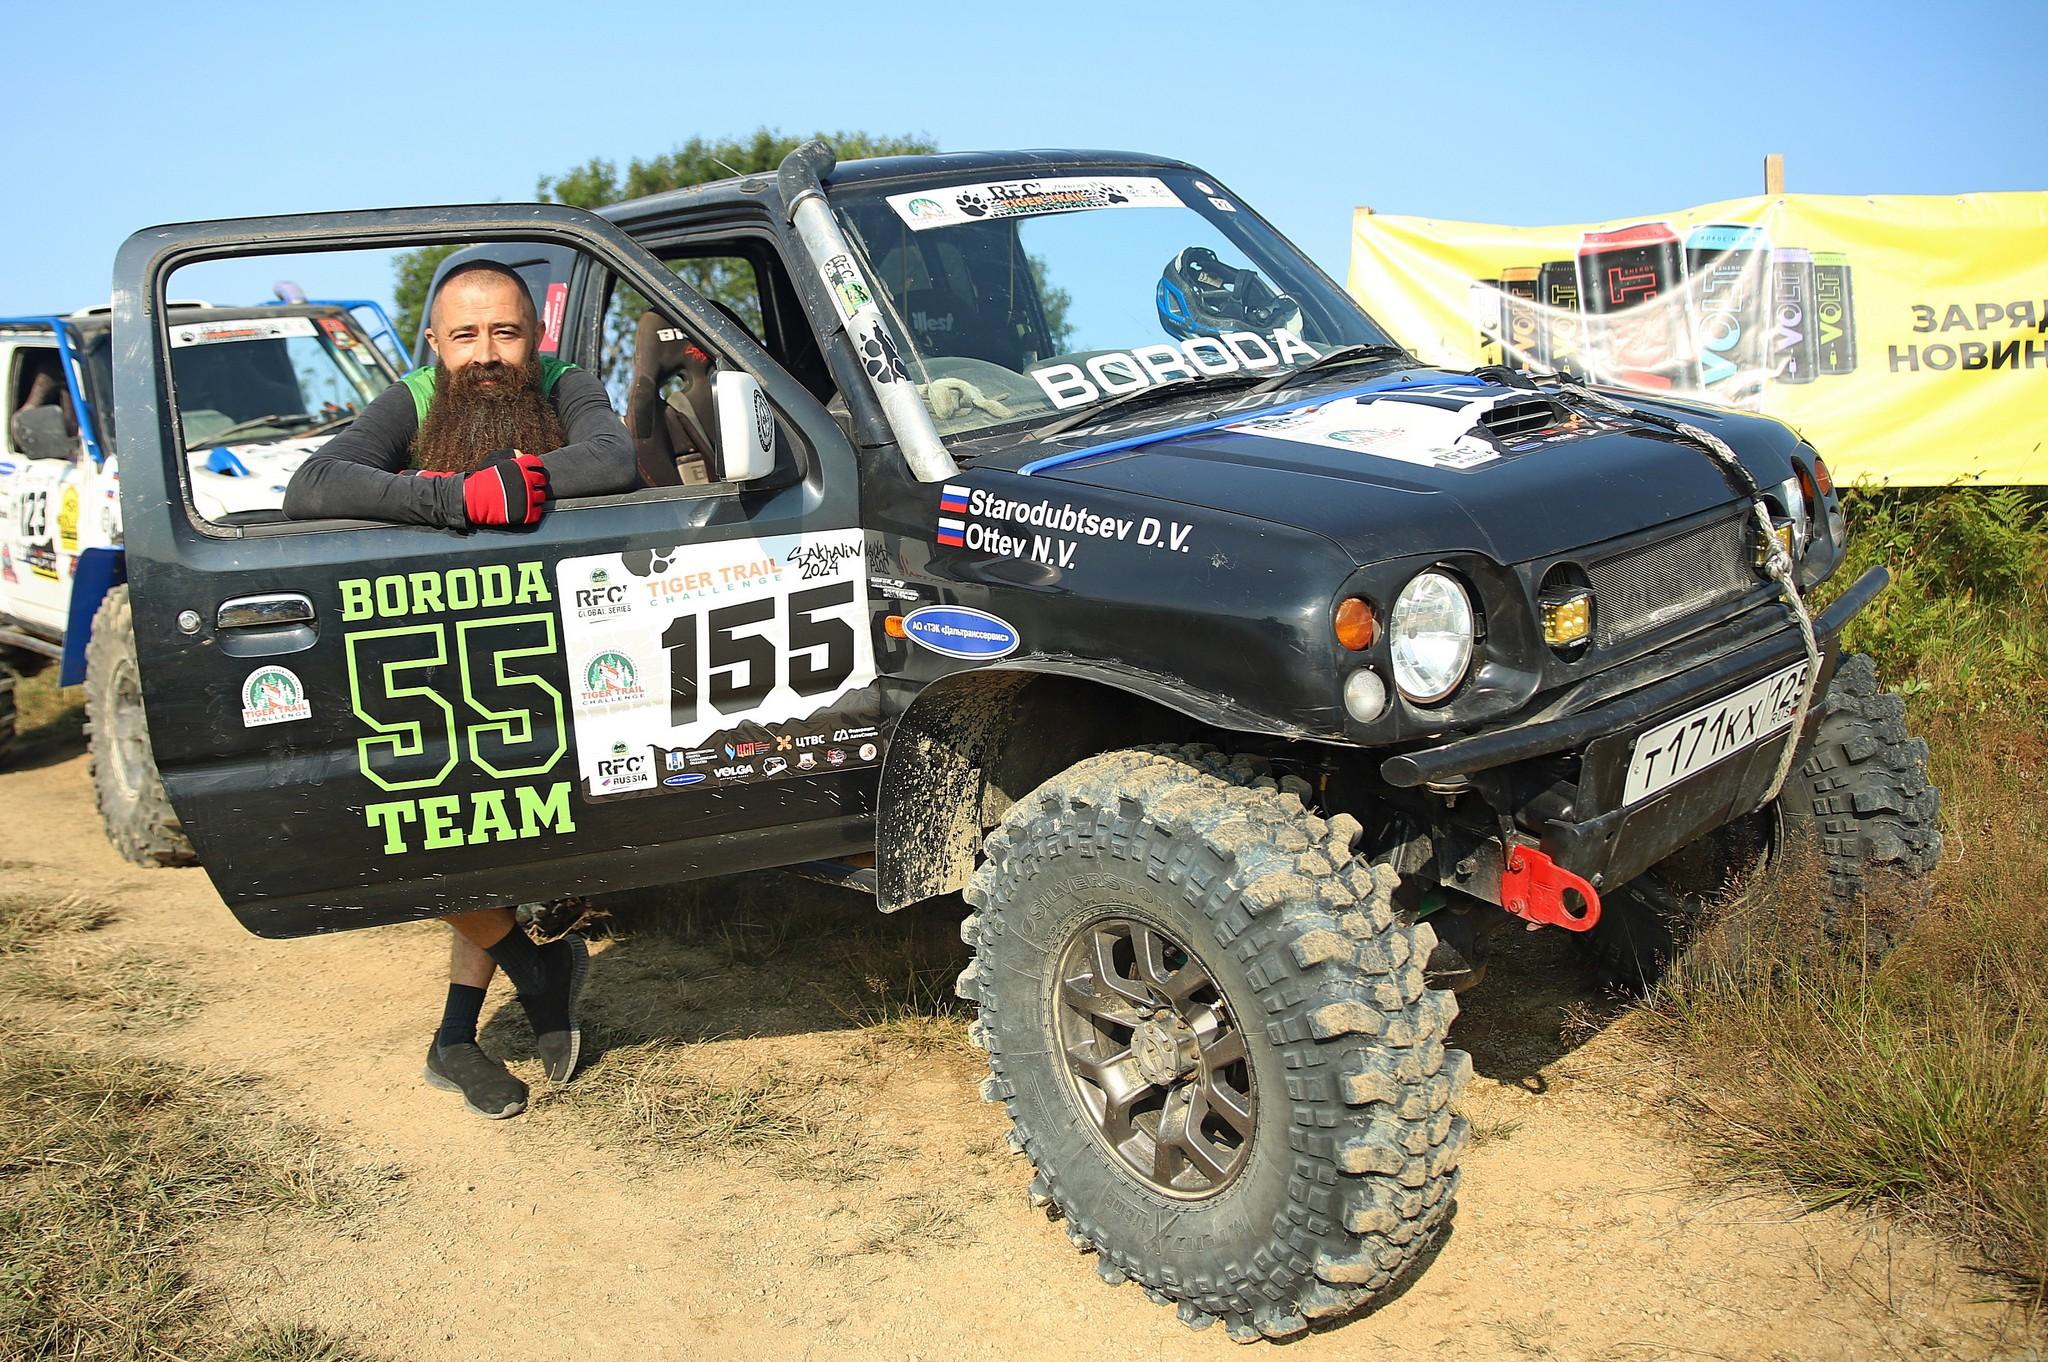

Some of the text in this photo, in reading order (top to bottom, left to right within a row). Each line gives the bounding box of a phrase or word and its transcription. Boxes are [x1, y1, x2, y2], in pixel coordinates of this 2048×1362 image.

[1774, 270, 1804, 352] VOLT
[1817, 272, 1844, 345] VOLT
[912, 311, 953, 332] illest
[1030, 328, 1323, 410] BORODA
[969, 490, 1193, 553] Starodubtsev D.V.
[965, 524, 1078, 570] Ottev N.V.
[802, 556, 839, 580] 2024
[646, 560, 783, 598] TIGER TRAIL
[338, 561, 552, 622] BORODA
[650, 574, 783, 607] CHALLENGE
[578, 605, 632, 618] GLOBAL SERIES
[912, 621, 922, 631] АО
[661, 580, 854, 728] 155
[344, 612, 567, 792] 55
[581, 686, 645, 700] TIGER TRAIL
[582, 693, 646, 706] CHALLENGE
[245, 703, 309, 719] TIGER TRAIL
[246, 711, 309, 725] CHALLENGE
[1770, 706, 1791, 726] RUS
[736, 742, 755, 758] ЦСП
[795, 734, 826, 748] ЦТВС
[613, 774, 648, 785] RUSSIA
[713, 764, 754, 778] VOLGA
